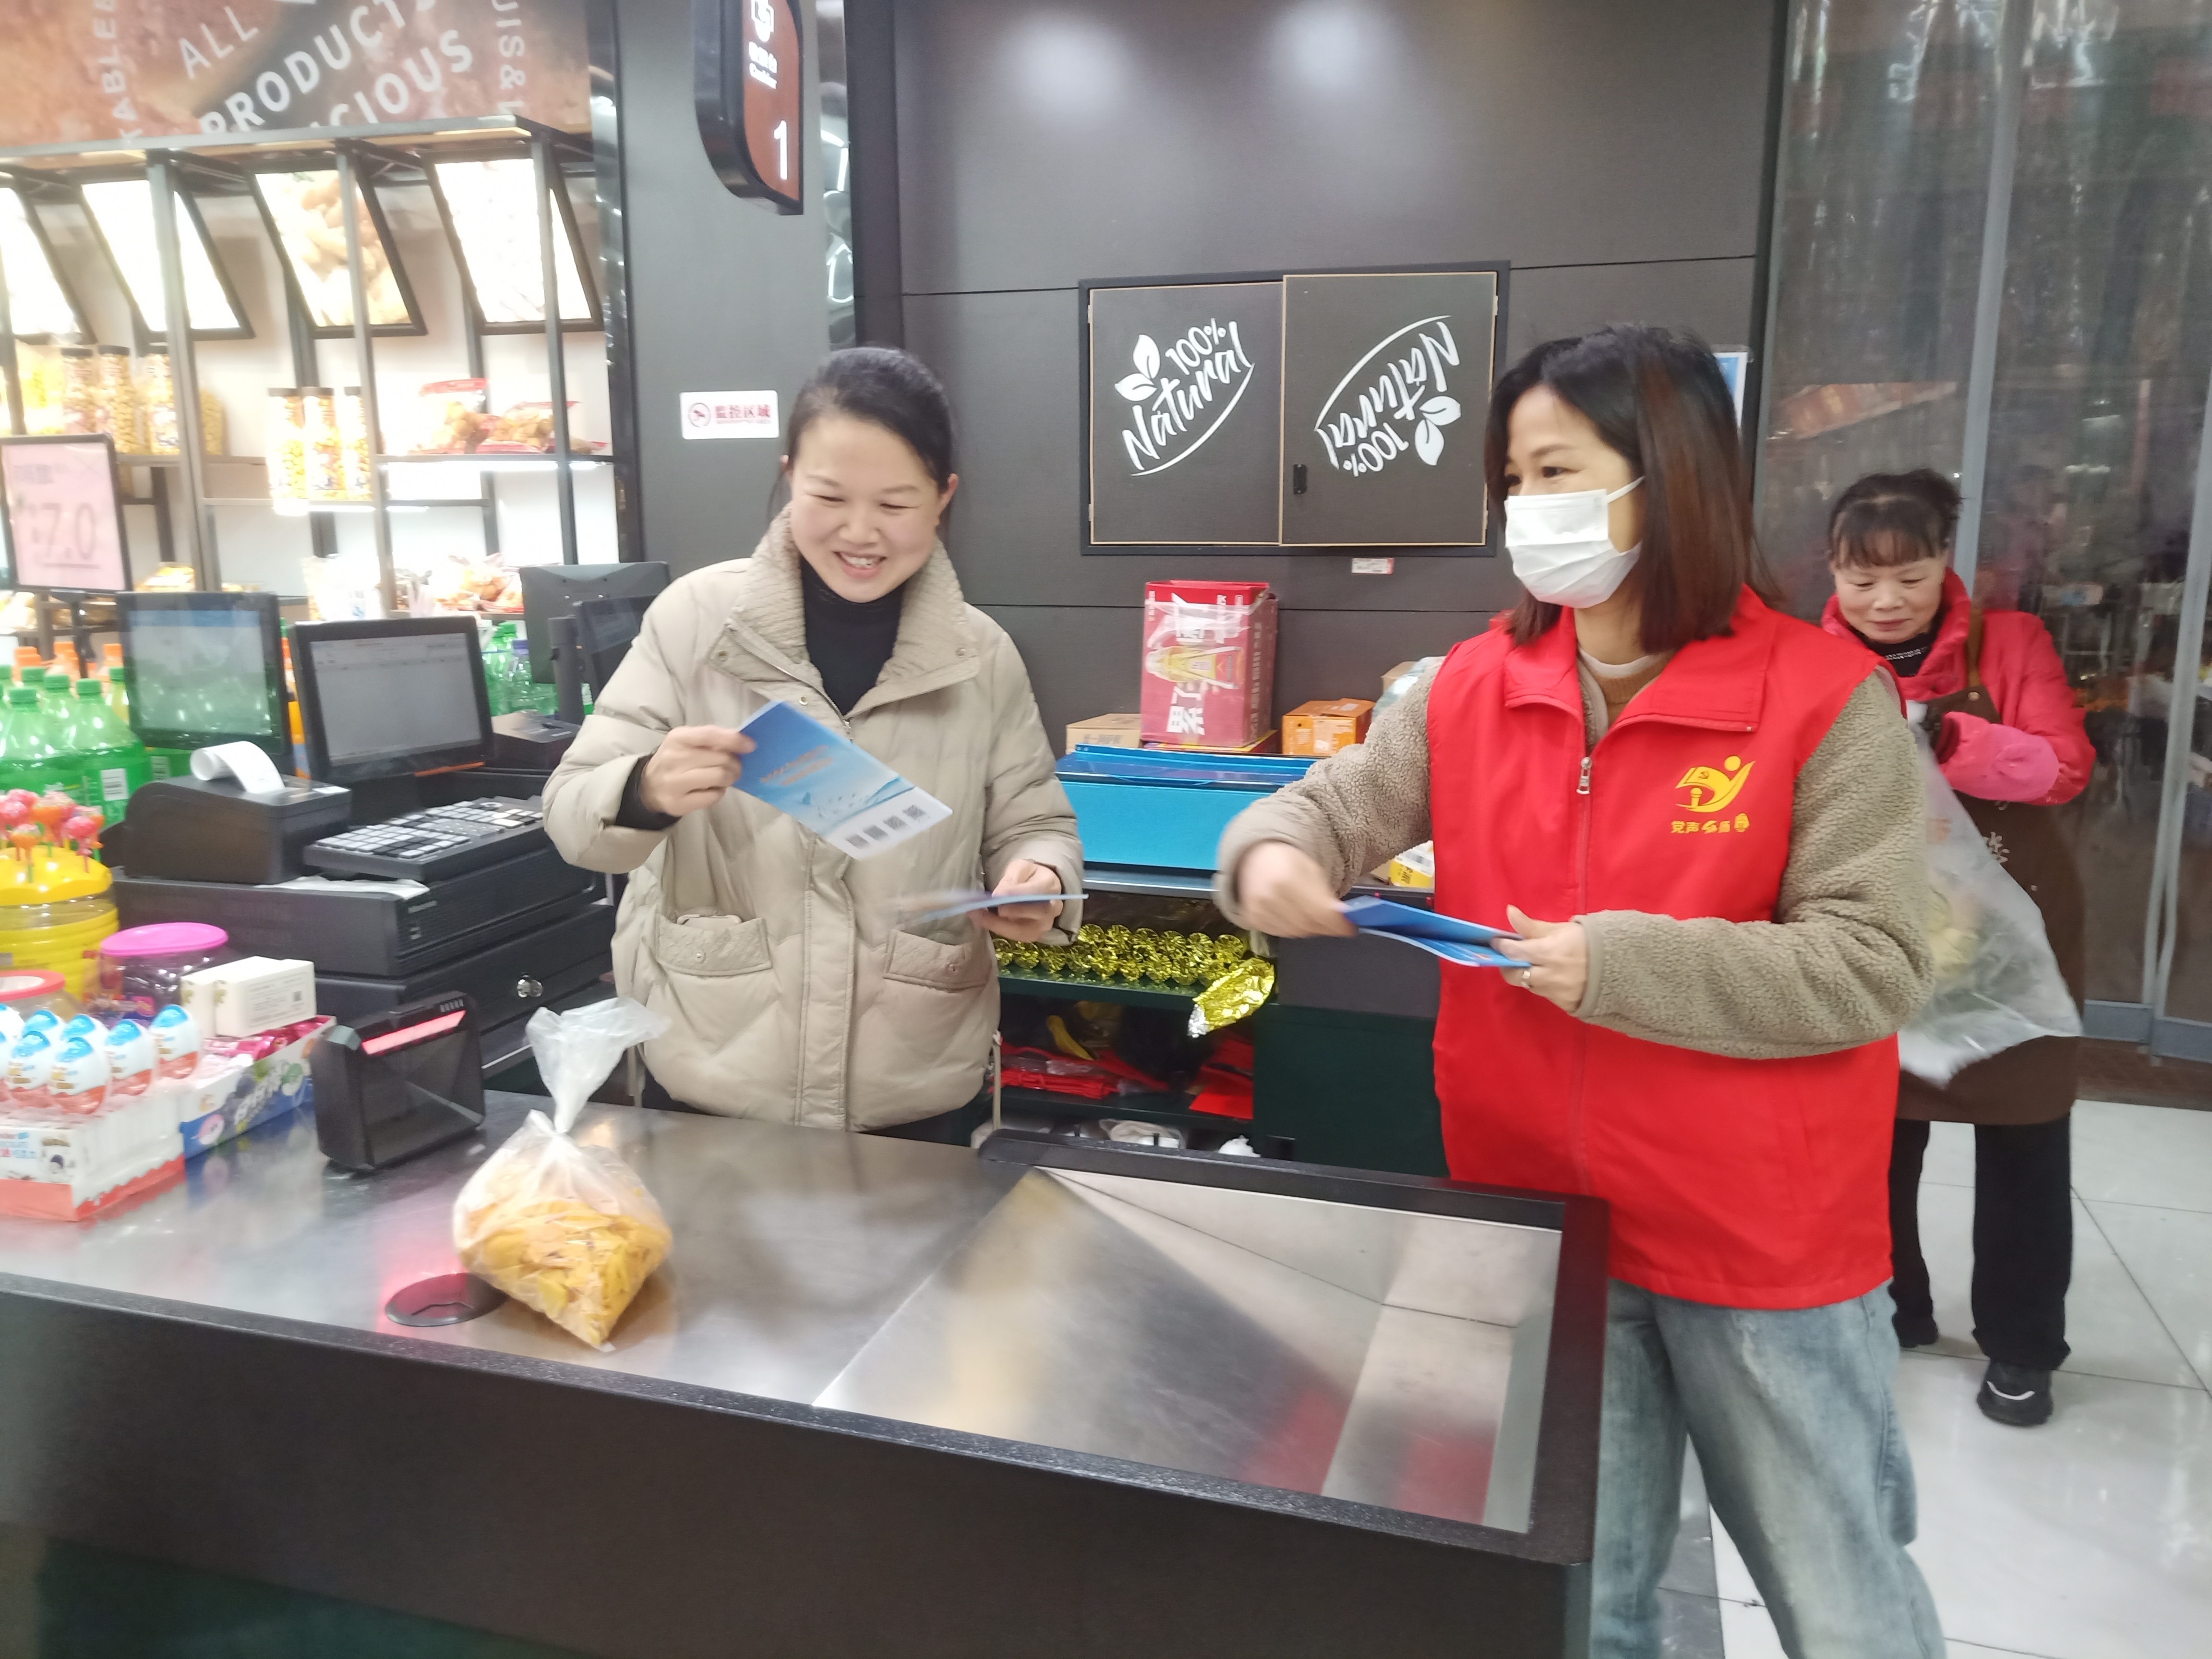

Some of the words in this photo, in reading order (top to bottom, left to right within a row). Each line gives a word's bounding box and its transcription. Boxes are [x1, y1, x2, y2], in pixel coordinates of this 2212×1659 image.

[179, 6, 259, 79] ALL
[198, 0, 436, 133] PRODUCT
[311, 29, 473, 127] CIOUS
[500, 64, 526, 89] &
[774, 120, 787, 180] 1
[1165, 318, 1226, 375] 100%
[1122, 321, 1252, 470] Natural
[1316, 321, 1460, 470] Natural
[1343, 422, 1409, 477] 100%
[1166, 686, 1205, 735] 累了
